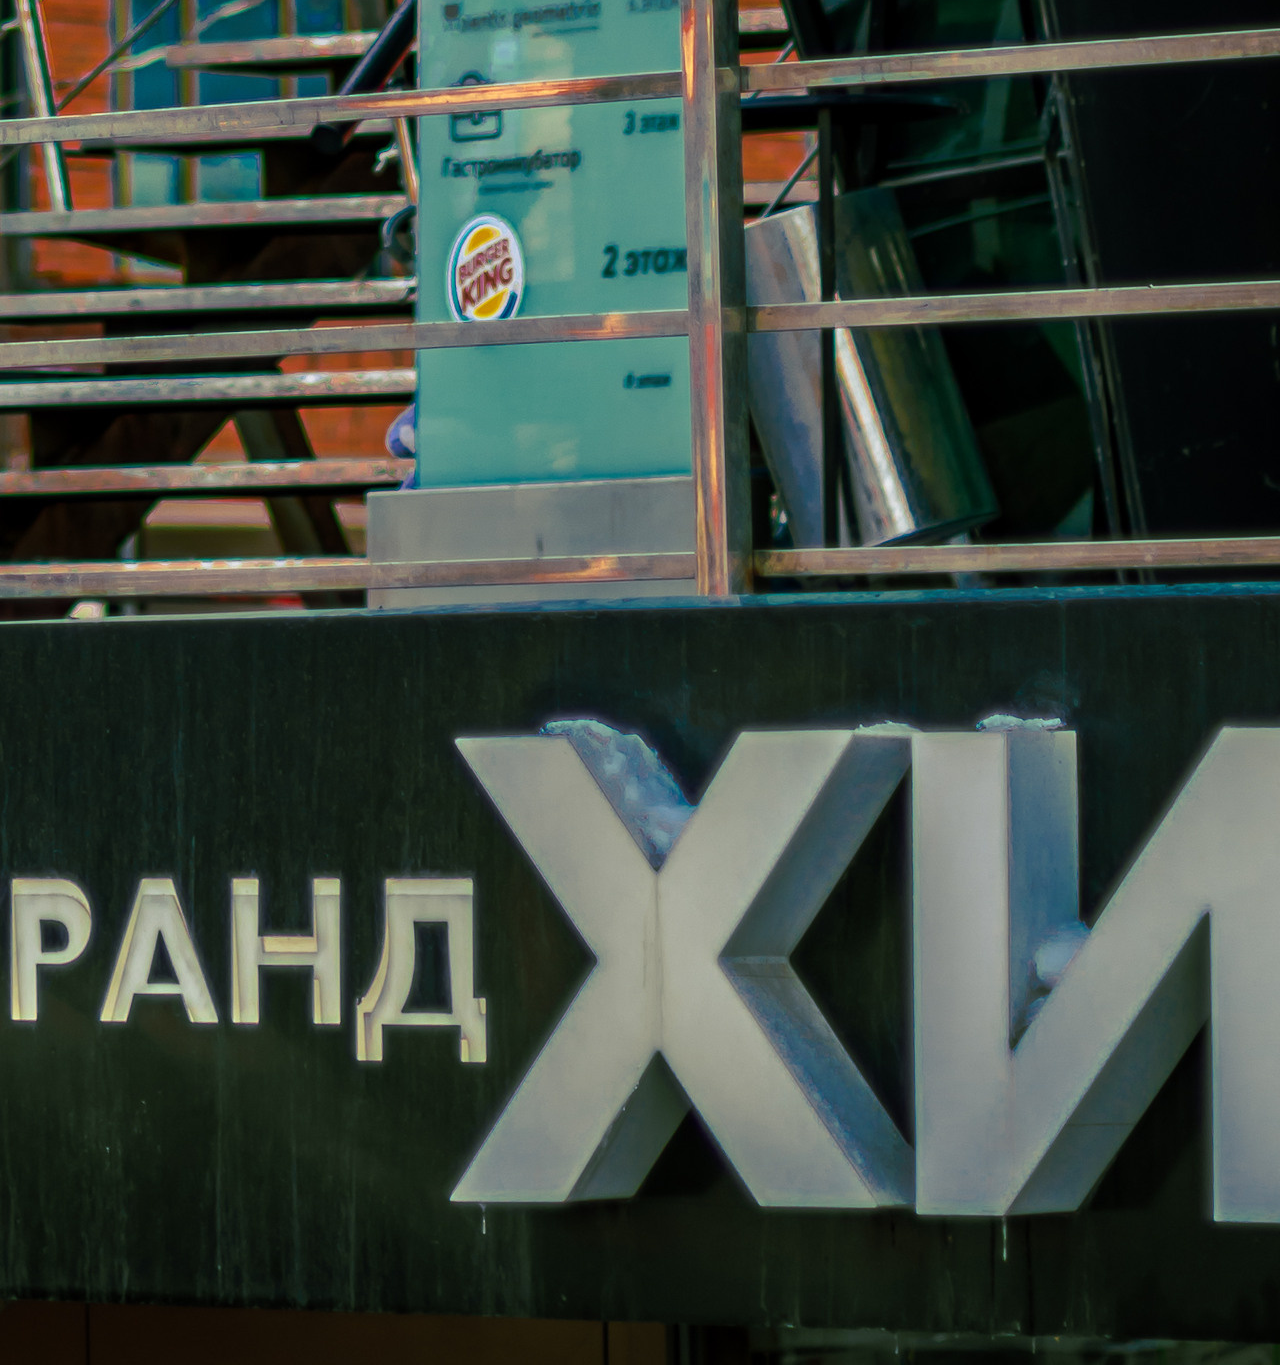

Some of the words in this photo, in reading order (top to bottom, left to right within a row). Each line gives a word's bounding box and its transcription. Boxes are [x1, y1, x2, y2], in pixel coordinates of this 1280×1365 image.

[623, 110, 636, 136] 3
[458, 238, 510, 286] BURGER
[601, 244, 619, 279] 2
[461, 257, 513, 315] KING
[449, 722, 1280, 1224] ХИ
